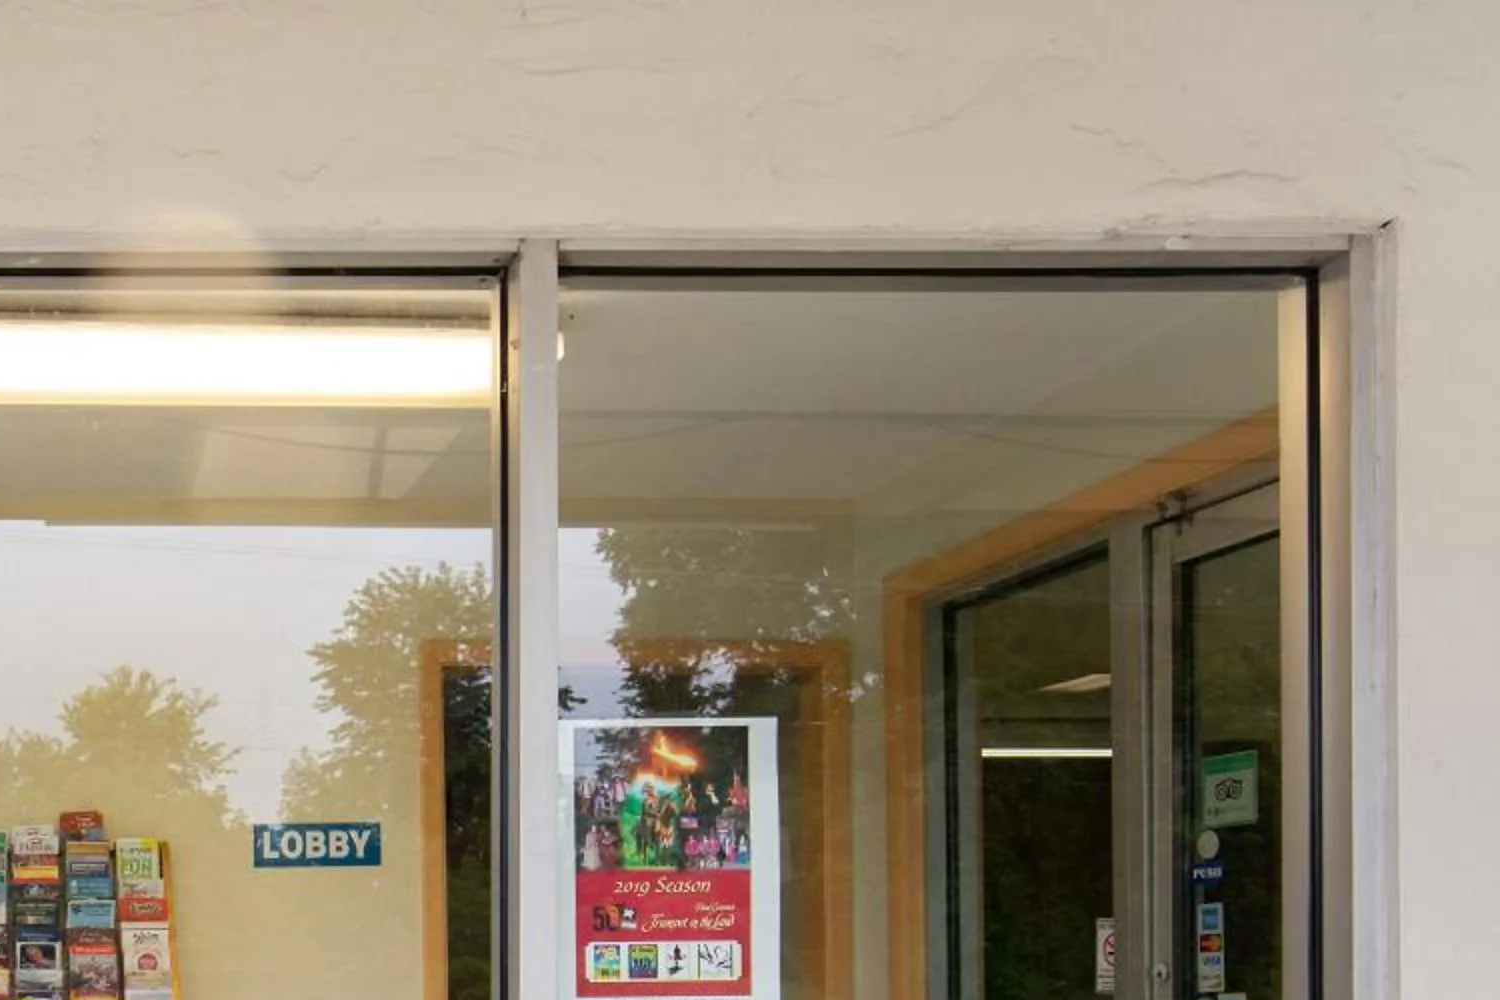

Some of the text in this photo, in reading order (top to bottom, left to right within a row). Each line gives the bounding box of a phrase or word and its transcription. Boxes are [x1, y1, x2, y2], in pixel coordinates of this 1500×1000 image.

[261, 829, 371, 860] LOBBY
[614, 875, 711, 897] 2019 Season
